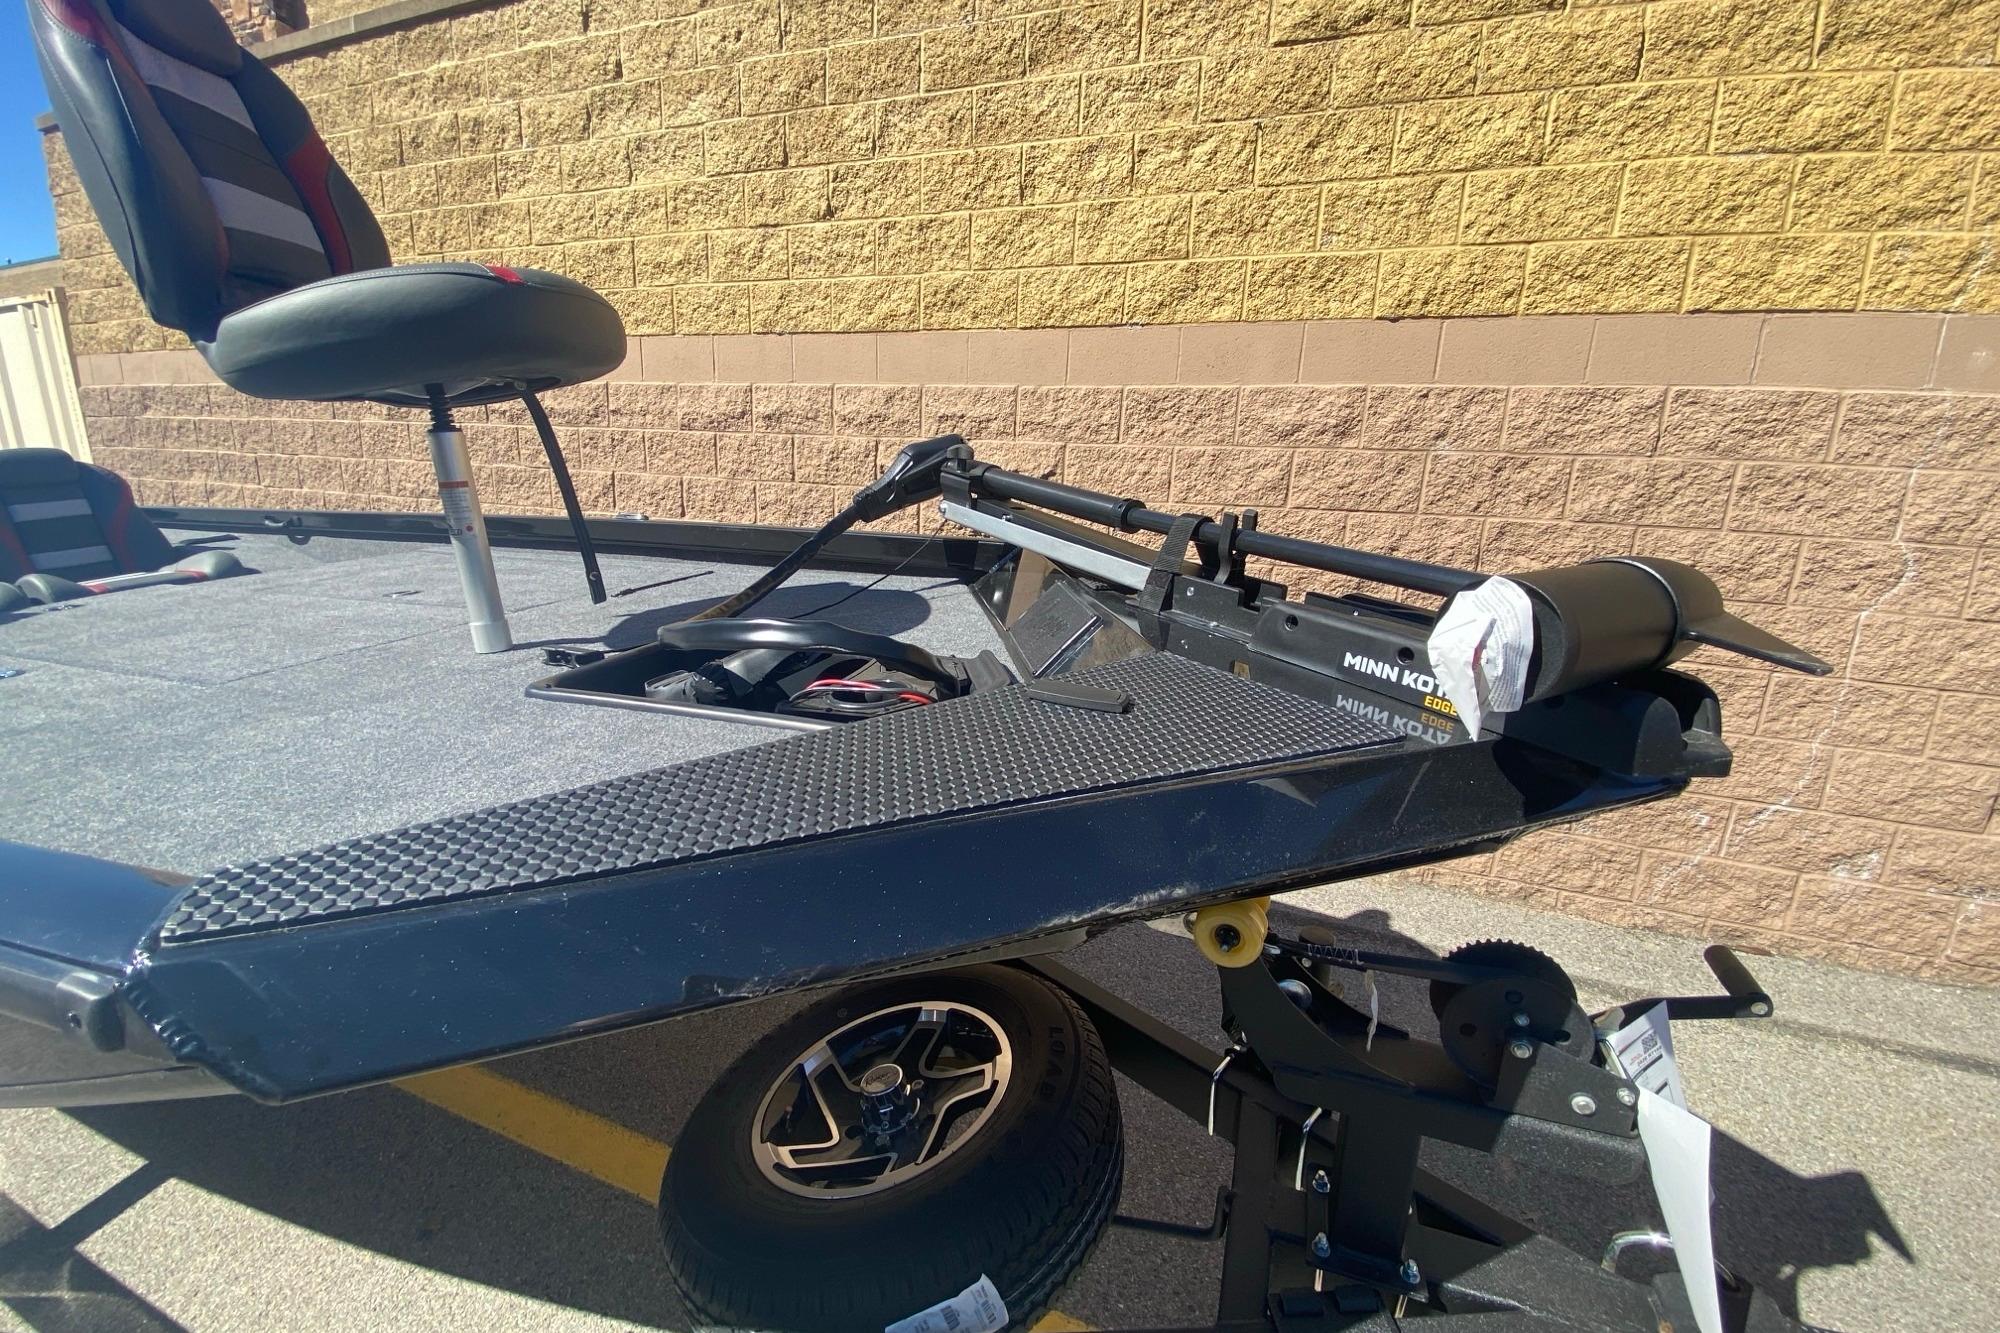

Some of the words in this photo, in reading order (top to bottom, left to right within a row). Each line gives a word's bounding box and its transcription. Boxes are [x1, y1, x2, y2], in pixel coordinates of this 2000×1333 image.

[1343, 651, 1400, 683] MINN
[1401, 669, 1449, 699] KOT
[1424, 695, 1458, 716] EDGE
